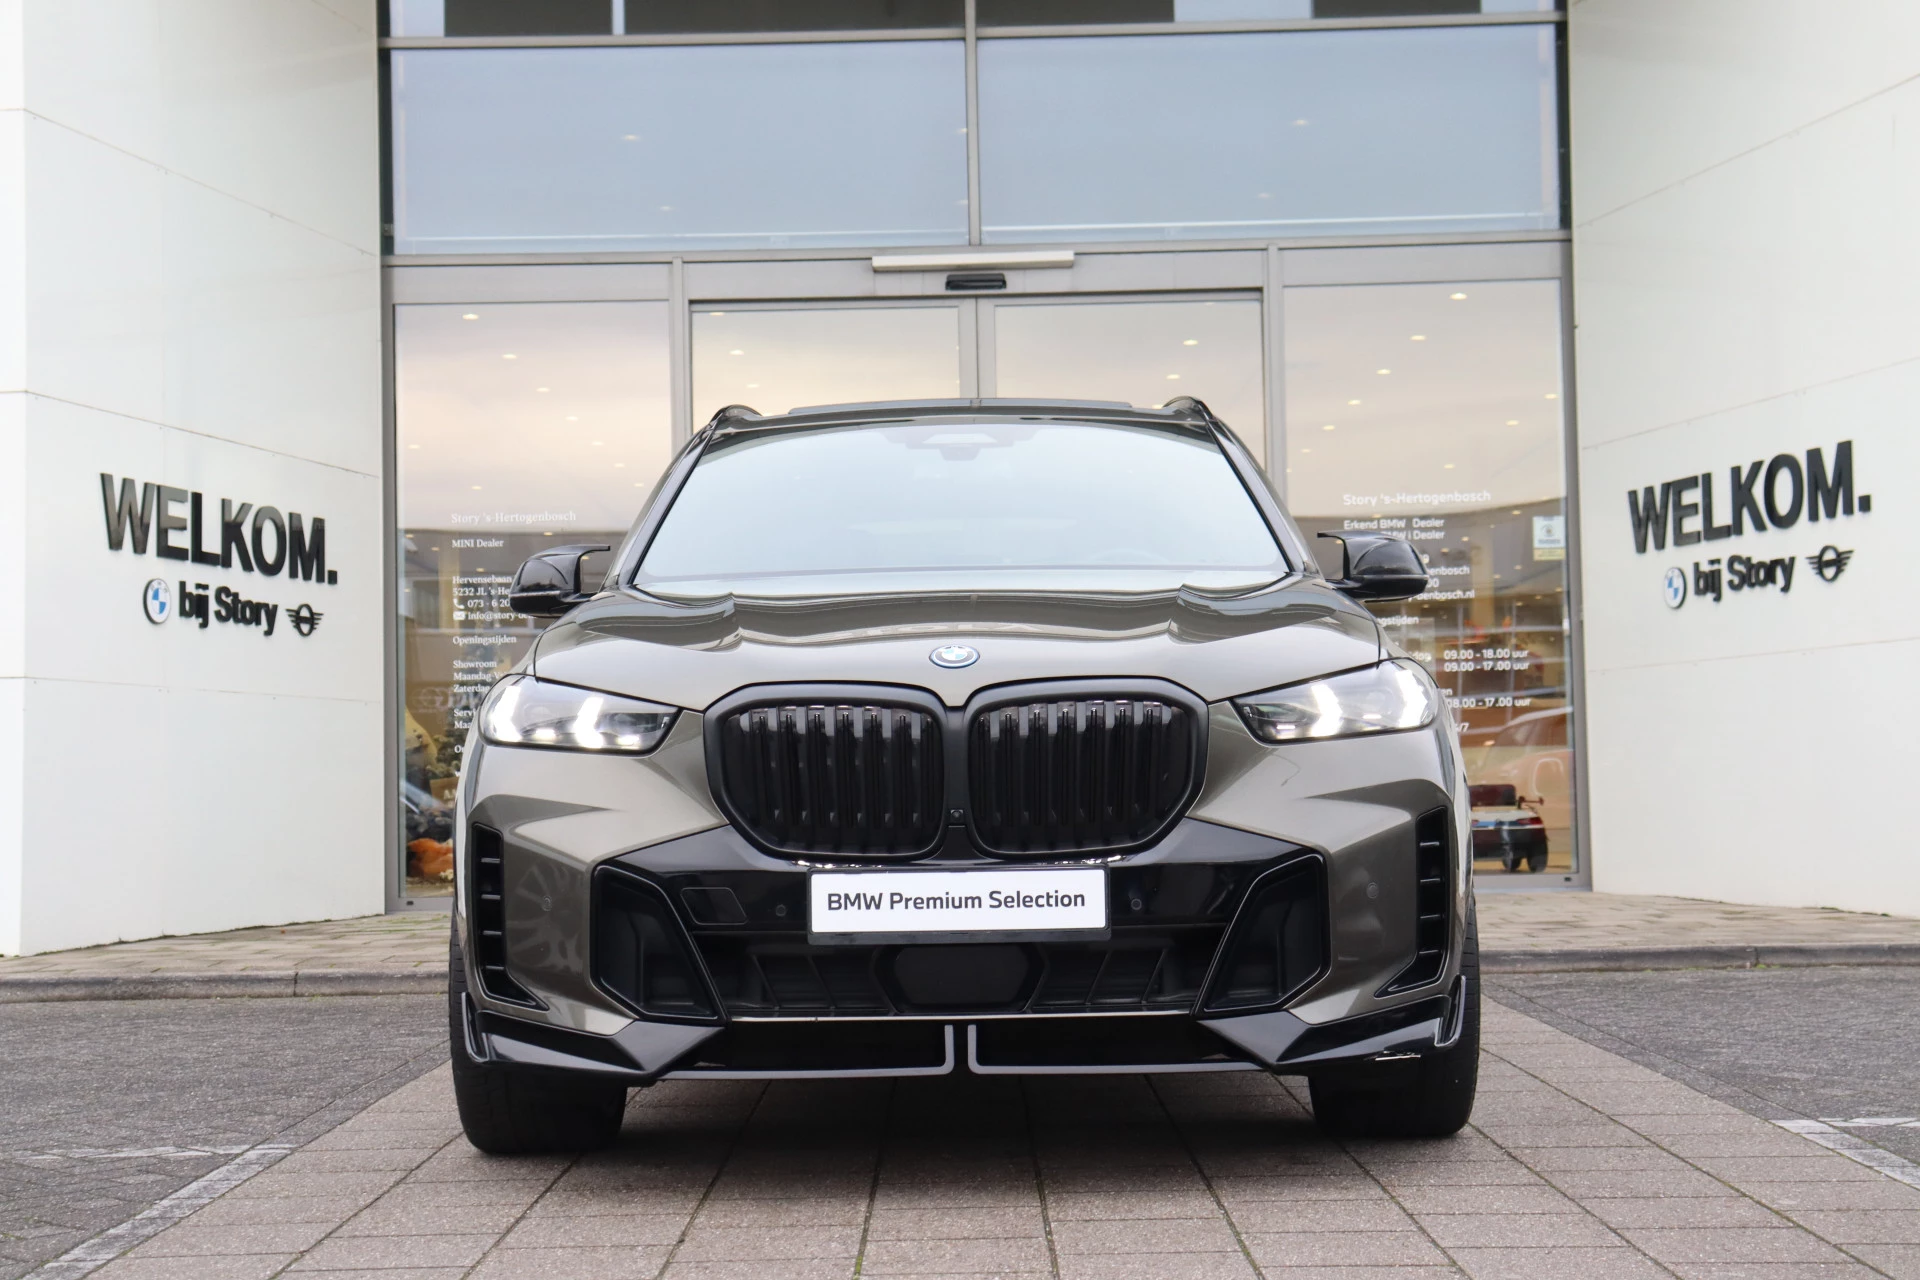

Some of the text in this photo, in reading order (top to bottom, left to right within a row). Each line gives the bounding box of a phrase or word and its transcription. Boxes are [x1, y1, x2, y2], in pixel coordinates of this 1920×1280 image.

[1343, 490, 1491, 507] Story 's-Hertogenbosch
[1627, 440, 1872, 554] WELKOM.
[451, 512, 481, 526] Story
[1343, 517, 1445, 530] Erkend BMW Dealer
[100, 472, 338, 585] WELKOM.
[1413, 530, 1446, 540] Dealer
[452, 537, 505, 549] MINI Dealer
[452, 574, 513, 585] Hervensebaan
[1693, 554, 1796, 602] bij Story
[452, 587, 474, 597] 5232
[476, 587, 487, 596] JL
[178, 580, 279, 637] bij Story
[467, 599, 484, 608] 073
[491, 599, 497, 608] 6
[499, 599, 511, 608] 20
[452, 635, 518, 646] Openingstijden
[1443, 649, 1474, 661] 09.00
[1481, 648, 1510, 659] 18.00
[1511, 649, 1530, 659] uur
[453, 659, 497, 669] Showroom
[1443, 661, 1475, 672] 09.00
[1512, 661, 1531, 671] uur
[1514, 698, 1532, 707] uur
[827, 889, 1086, 911] BMW Premium Selection
